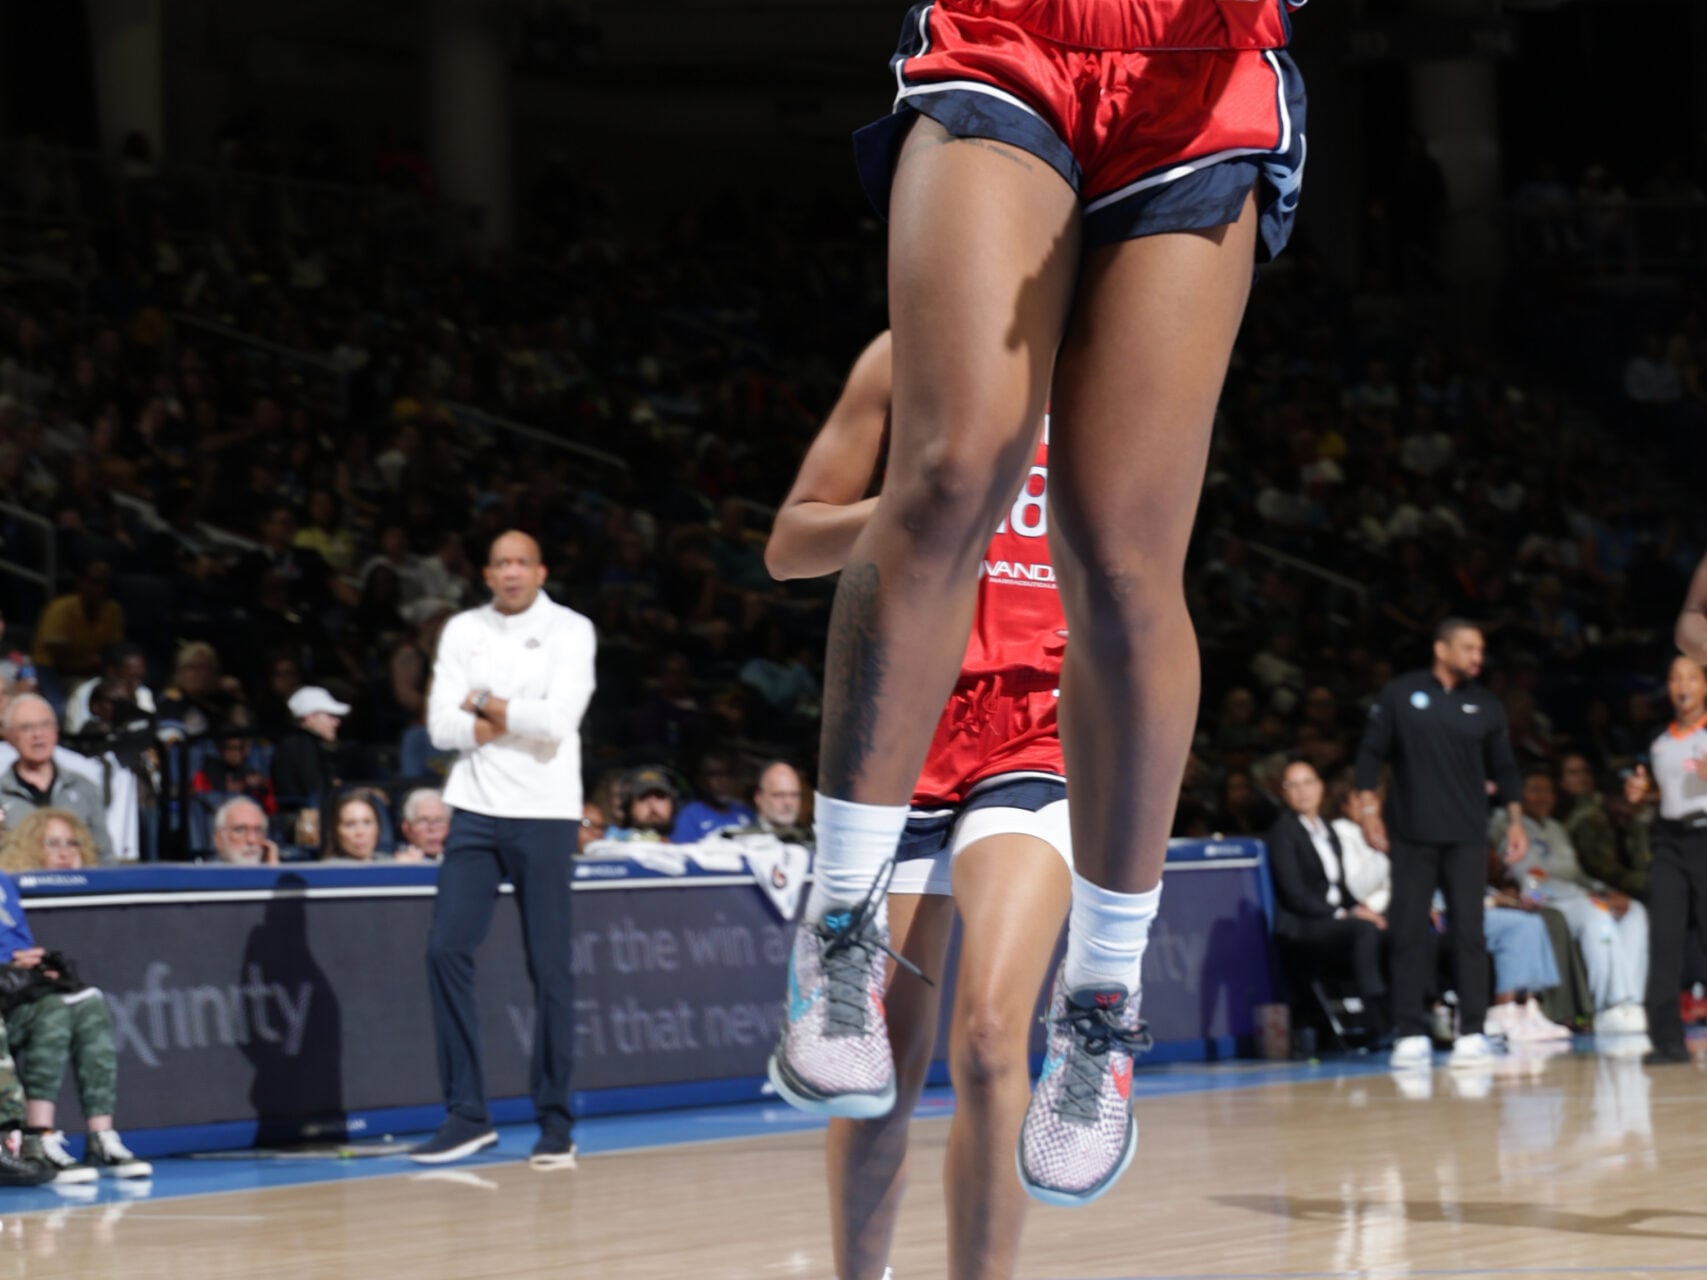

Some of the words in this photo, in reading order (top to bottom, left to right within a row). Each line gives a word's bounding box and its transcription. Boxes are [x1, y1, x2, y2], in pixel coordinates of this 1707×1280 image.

[996, 466, 1047, 538] 8
[984, 559, 1056, 582] VAND
[609, 915, 678, 973] the
[684, 911, 758, 967] win
[104, 959, 313, 1067] xfinity
[610, 997, 699, 1055] that
